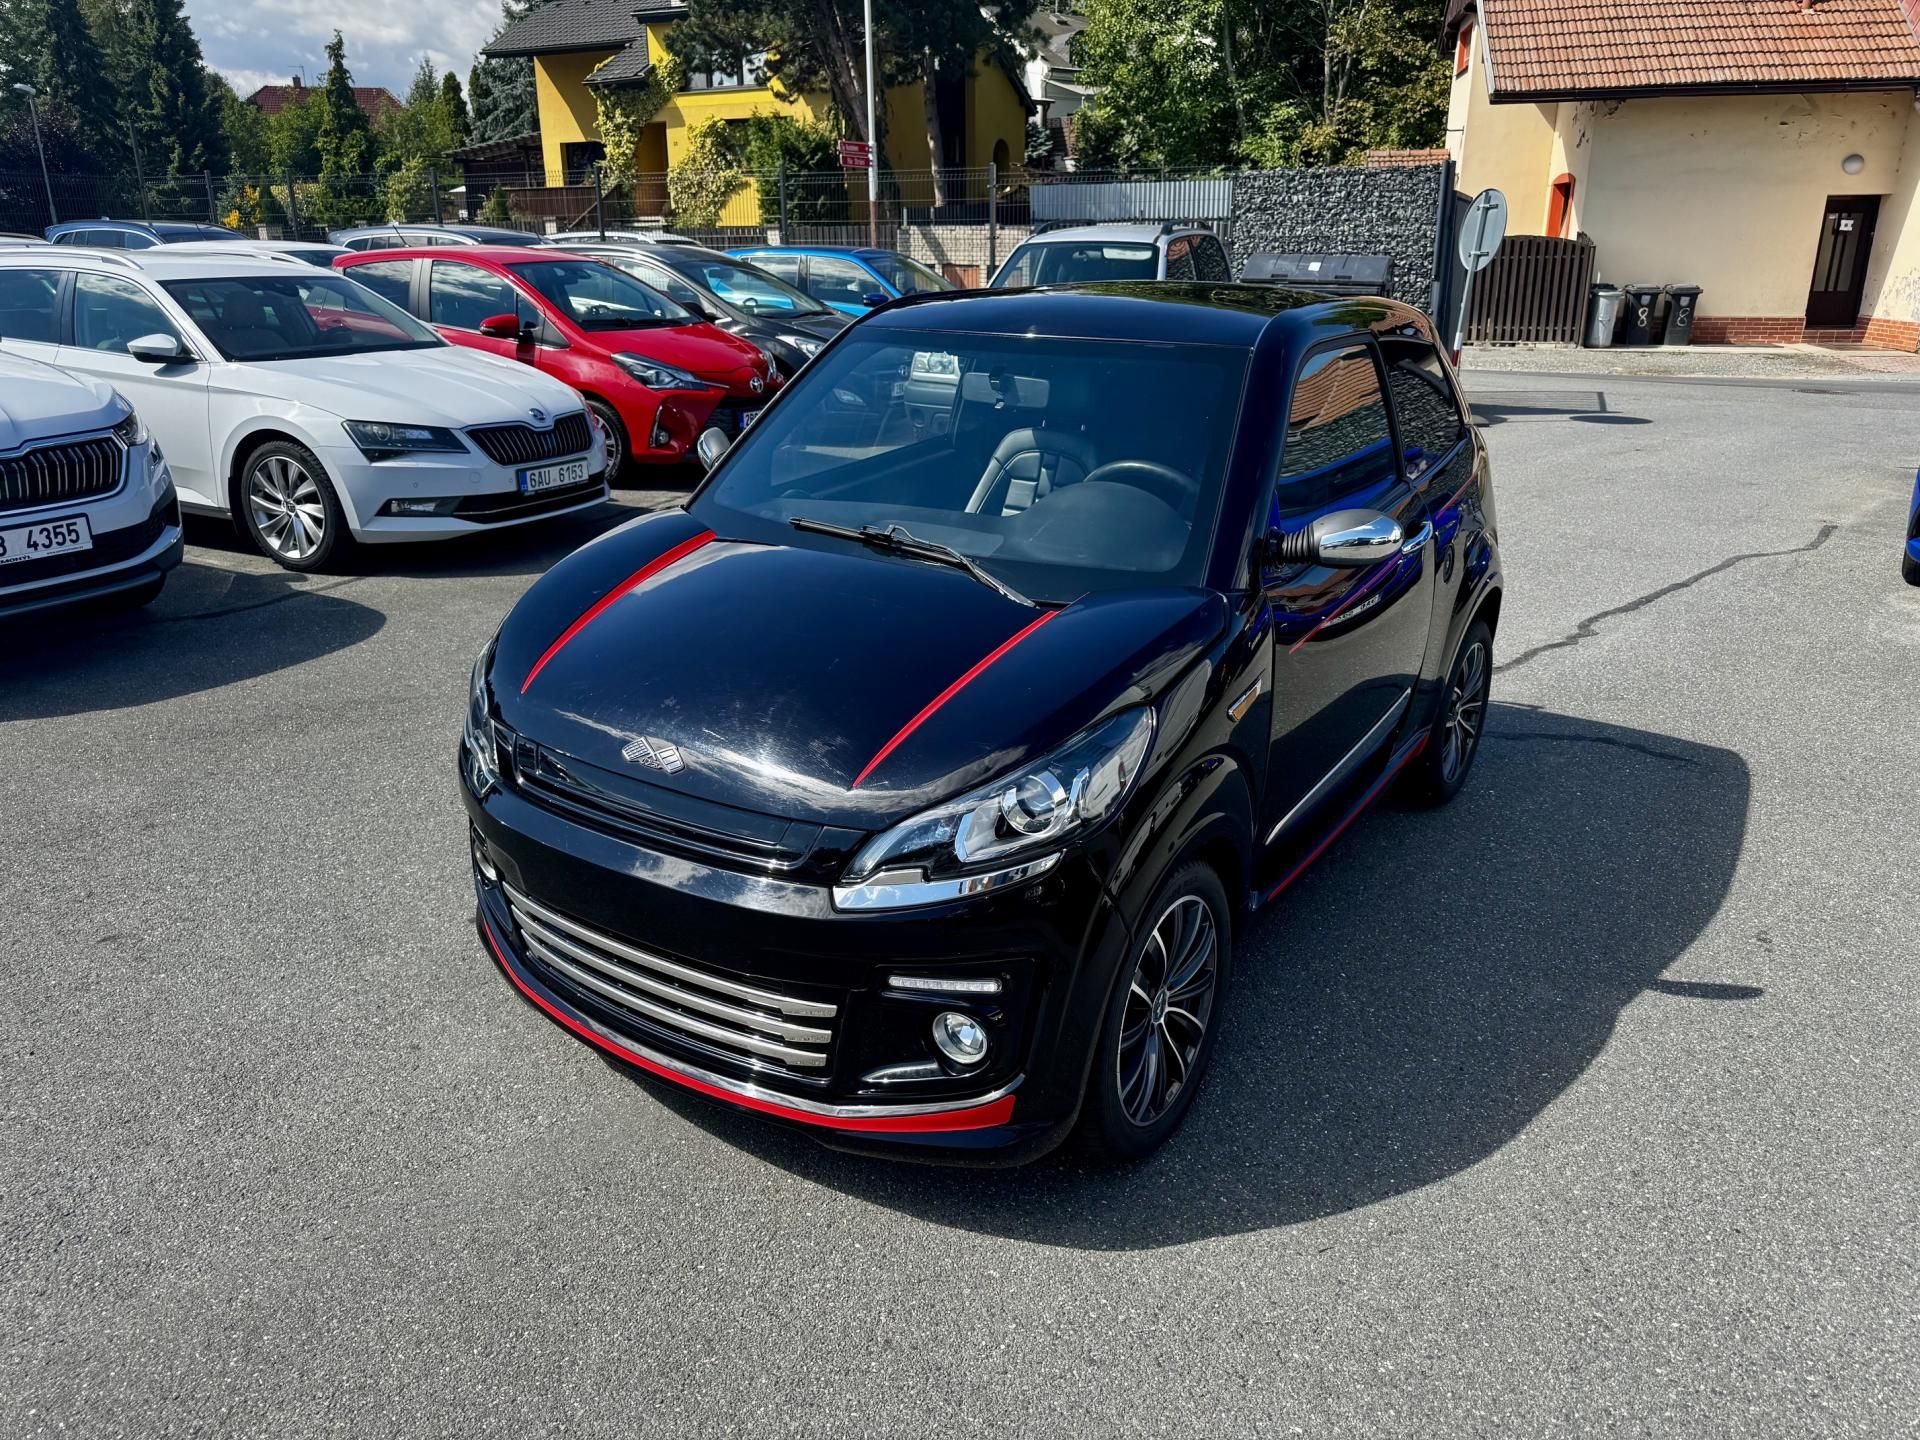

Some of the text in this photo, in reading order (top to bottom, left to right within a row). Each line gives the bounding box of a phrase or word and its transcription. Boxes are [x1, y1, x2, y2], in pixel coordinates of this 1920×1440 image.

[1637, 307, 1649, 327] 8
[1677, 307, 1691, 327] 8
[529, 463, 583, 488] 6AU 6153
[27, 521, 80, 551] 4355
